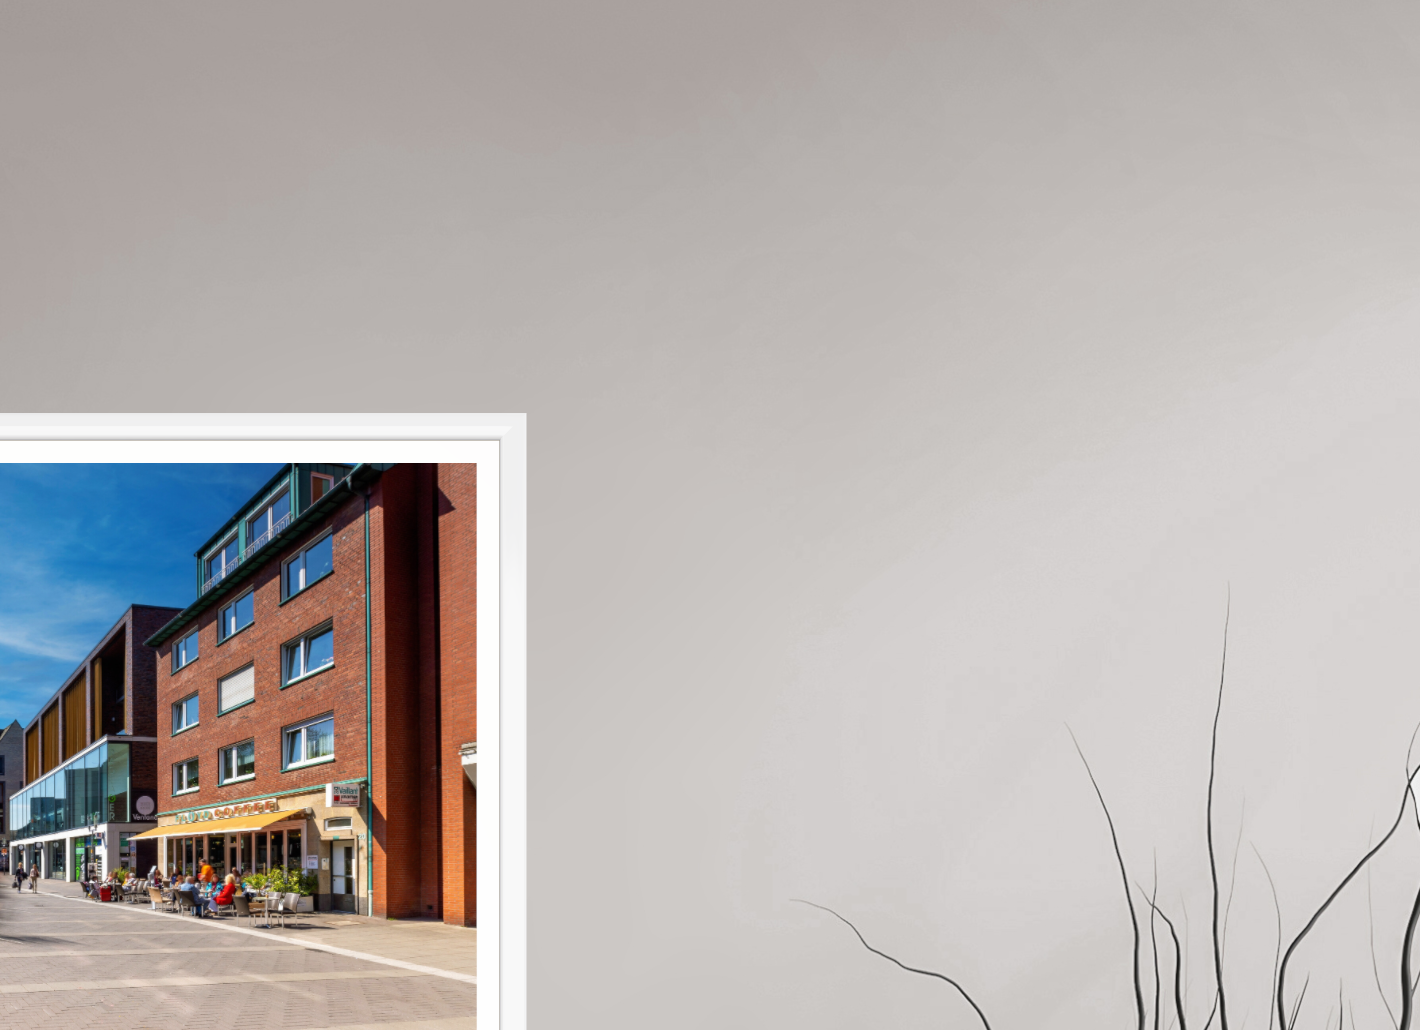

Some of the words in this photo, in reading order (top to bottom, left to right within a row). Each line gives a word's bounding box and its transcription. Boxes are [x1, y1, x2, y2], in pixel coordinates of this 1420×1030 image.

[175, 811, 211, 823] FLOYD
[214, 801, 275, 818] COFFEE
[358, 831, 366, 839] 20
